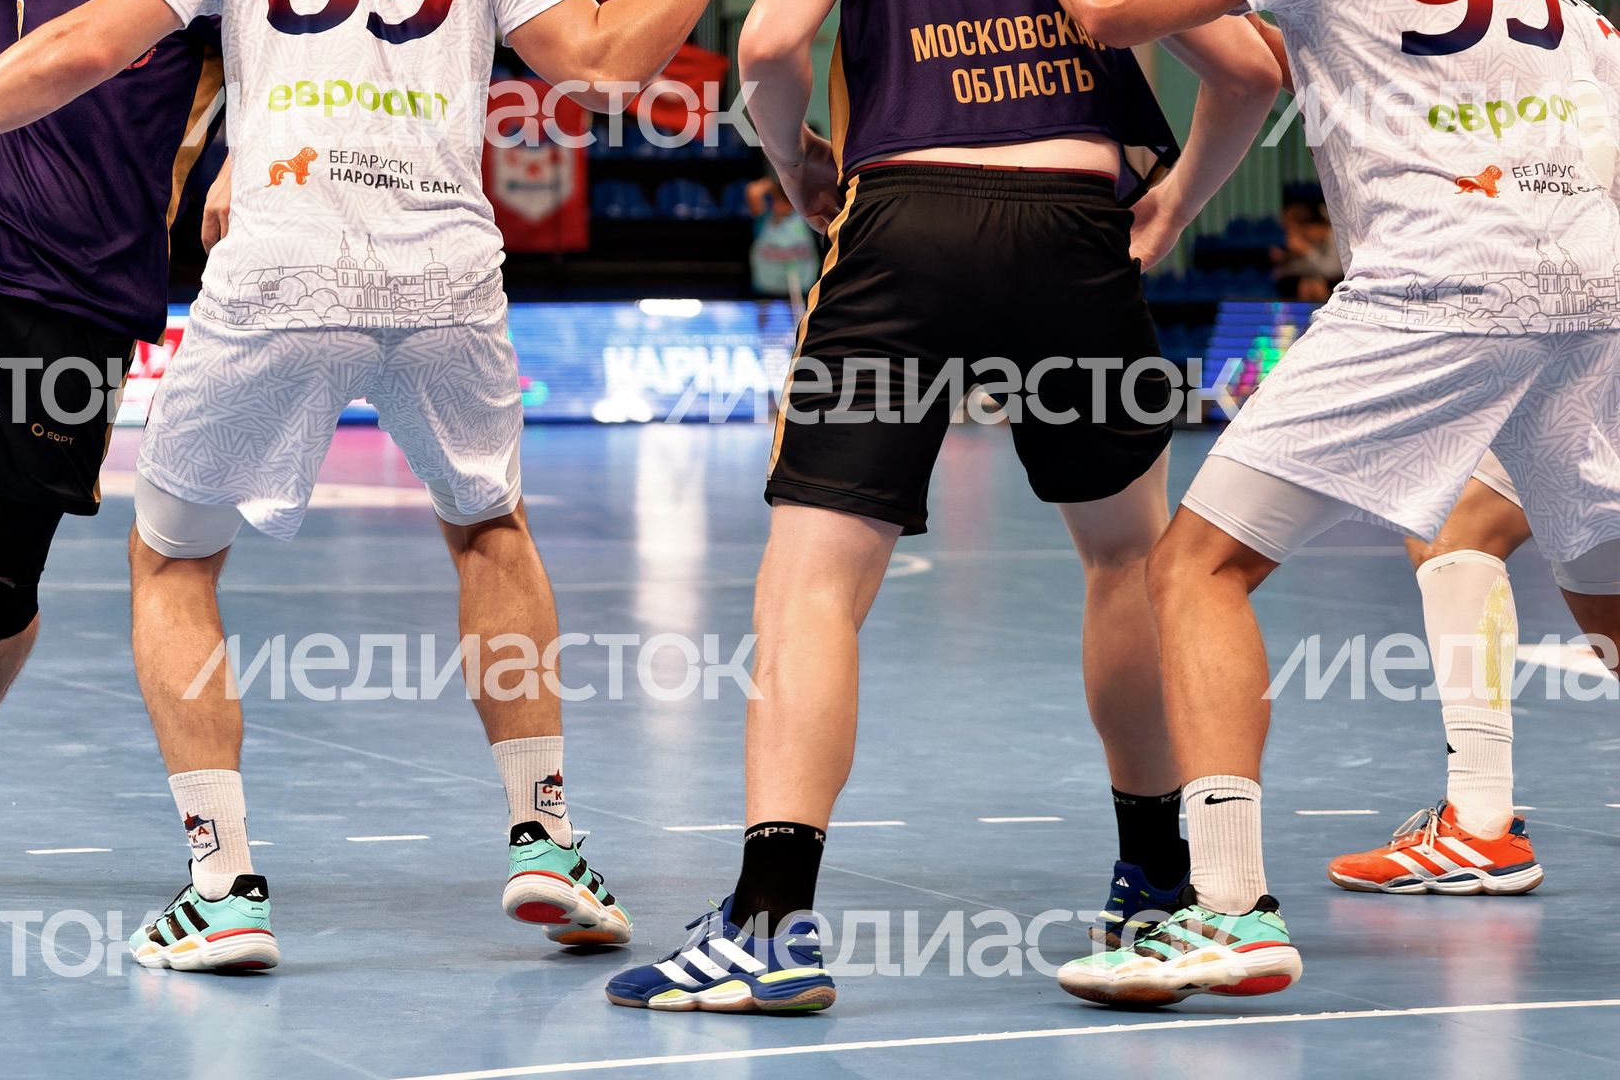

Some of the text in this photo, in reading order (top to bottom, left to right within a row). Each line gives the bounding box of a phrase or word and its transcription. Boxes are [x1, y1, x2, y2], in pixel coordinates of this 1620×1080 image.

[910, 10, 1108, 63] МОСКОВСКА
[268, 79, 449, 121] евроопт
[951, 57, 1095, 105] ОБЛАСТЬ
[329, 149, 414, 175] БЕЛАРУСКІ
[329, 167, 415, 191] НАРОДНЫ
